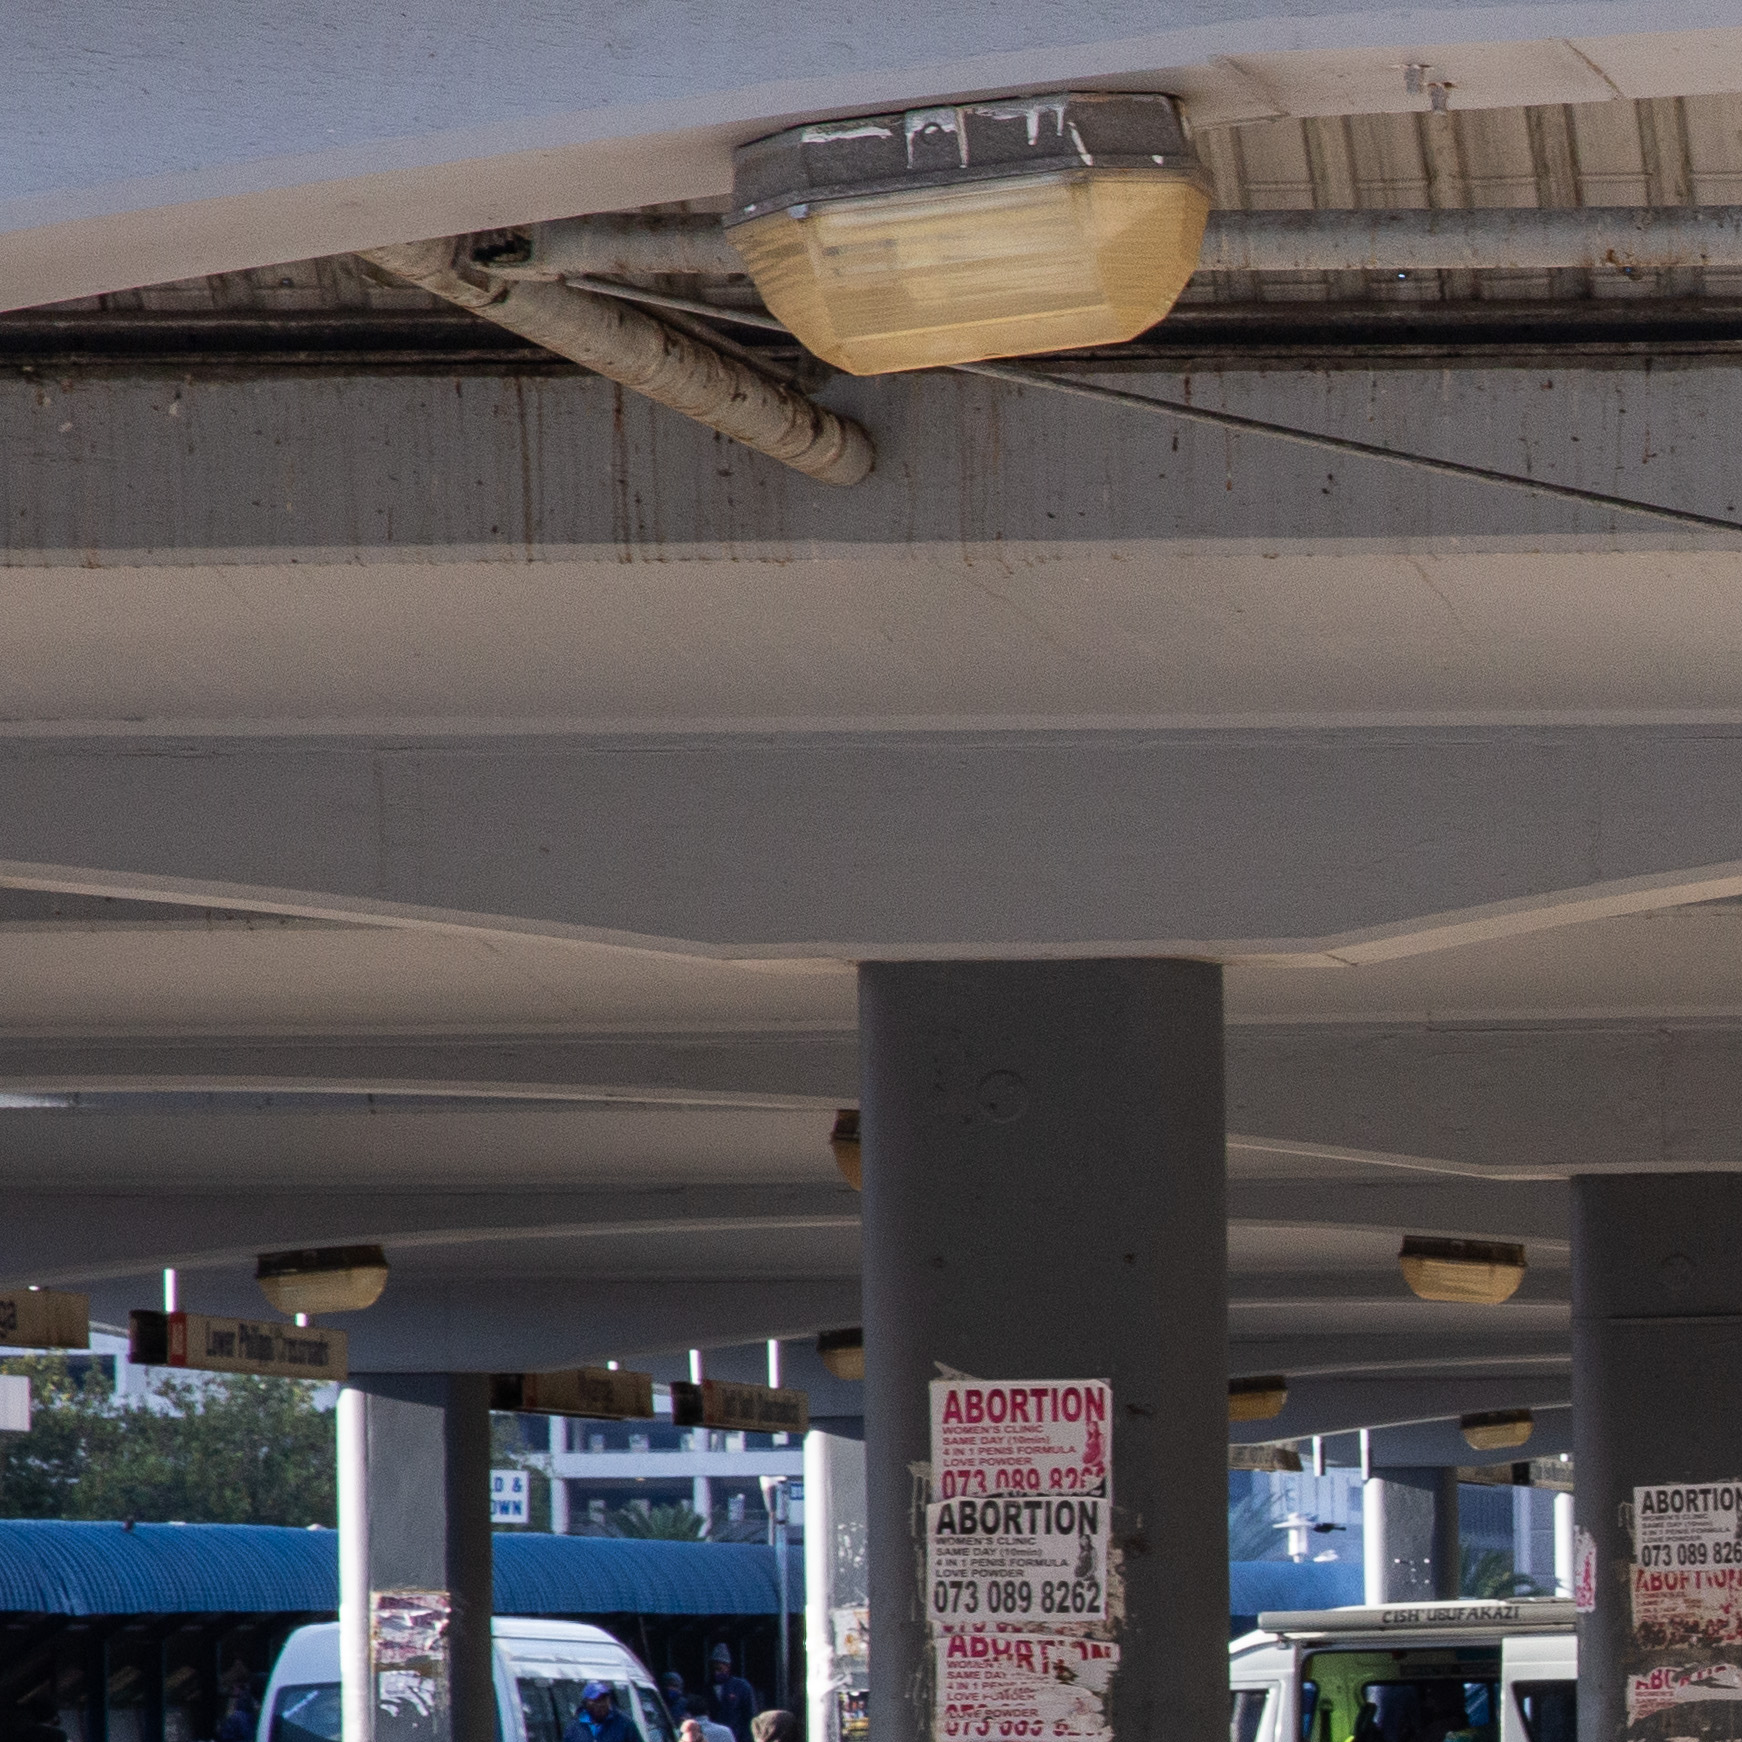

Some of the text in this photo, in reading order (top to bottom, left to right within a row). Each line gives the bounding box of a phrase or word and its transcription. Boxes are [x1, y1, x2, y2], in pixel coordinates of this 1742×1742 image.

[943, 1387, 1105, 1424] ABORTION
[942, 1424, 1044, 1435] WOMEN'S CLINIC
[942, 1436, 977, 1446] SAME
[980, 1436, 1004, 1445] DAY
[979, 1446, 1015, 1455] PENIS
[1018, 1445, 1077, 1455] FORMULA
[943, 1456, 1033, 1467] LOVE POWDER
[941, 1469, 987, 1500] 073
[936, 1501, 1098, 1534] ABORTION
[935, 1536, 1036, 1546] WOMEN'S CLINIC
[935, 1547, 969, 1557] SAME
[973, 1547, 997, 1556] DAY
[1641, 1544, 1673, 1567] 073
[1677, 1543, 1708, 1565] 089
[970, 1558, 1006, 1567] PENIS
[1009, 1558, 1069, 1568] FORMULA
[935, 1569, 1024, 1578] LOVE POWDER
[934, 1580, 1101, 1614] 073 089 8262
